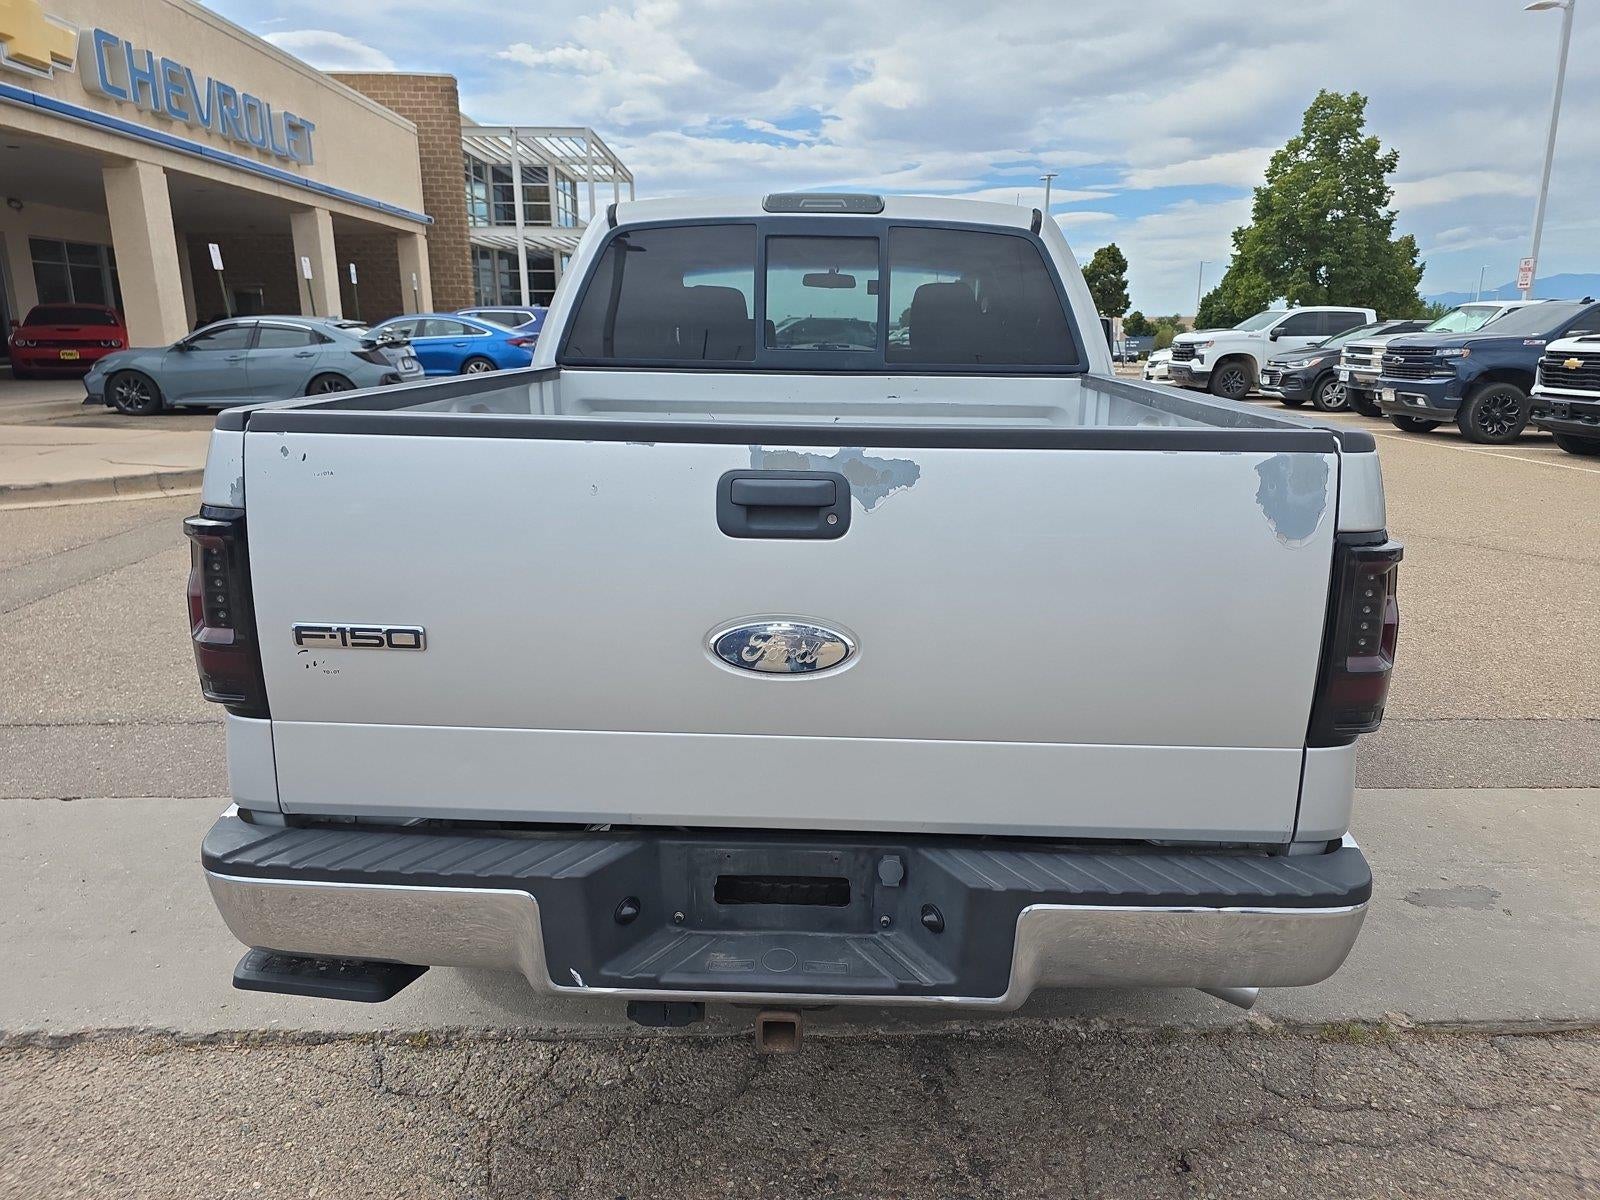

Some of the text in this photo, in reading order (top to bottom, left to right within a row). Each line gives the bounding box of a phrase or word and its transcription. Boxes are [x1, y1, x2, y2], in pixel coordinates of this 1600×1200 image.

[92, 27, 316, 166] CHEVROLET
[294, 625, 422, 649] F-150
[741, 632, 820, 664] Ford
